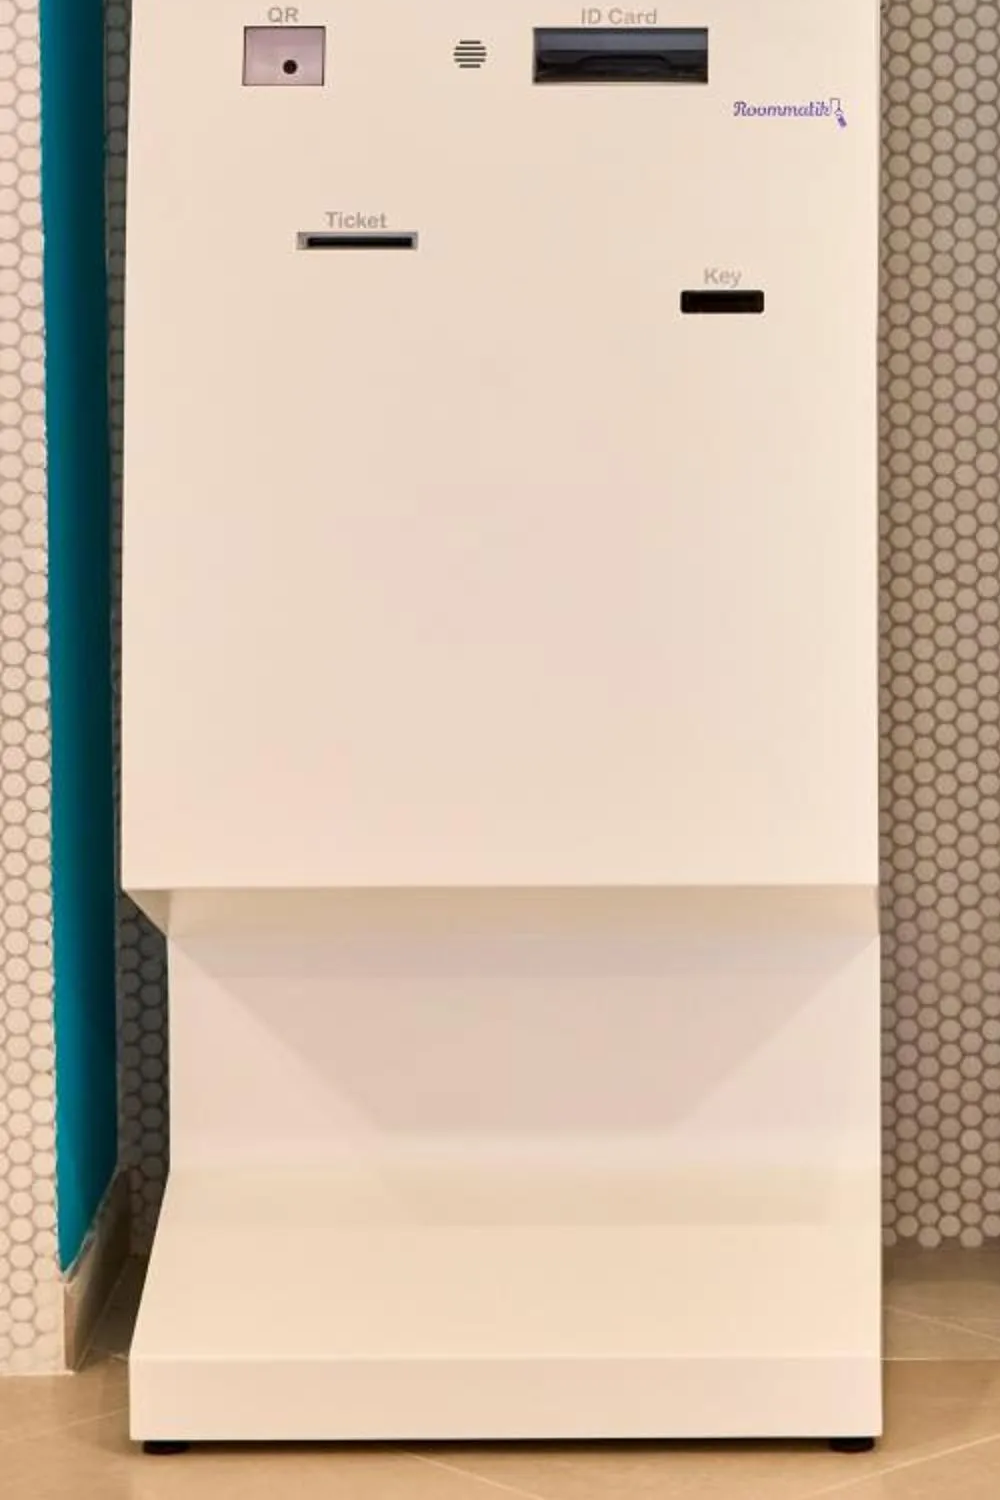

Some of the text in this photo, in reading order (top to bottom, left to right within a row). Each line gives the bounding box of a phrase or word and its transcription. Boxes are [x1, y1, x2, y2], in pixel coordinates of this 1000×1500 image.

[267, 6, 300, 23] QR
[581, 7, 658, 25] ID Card
[325, 211, 388, 229] Ticket
[704, 267, 742, 289] Key
